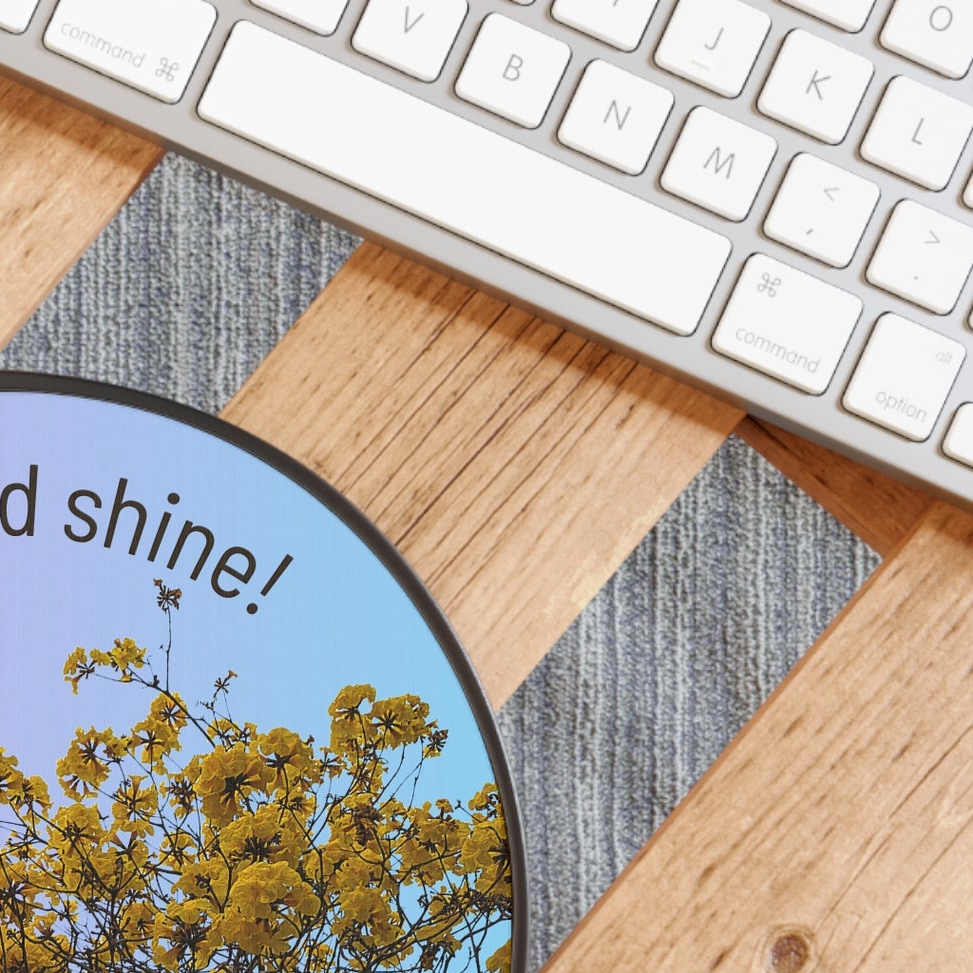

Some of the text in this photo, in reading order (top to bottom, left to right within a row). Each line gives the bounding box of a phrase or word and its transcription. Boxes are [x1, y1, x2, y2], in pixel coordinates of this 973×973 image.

[403, 5, 425, 34] V
[60, 20, 147, 69] command
[703, 26, 725, 51] J
[501, 53, 525, 82] B
[805, 69, 832, 101] K
[602, 99, 632, 131] N
[910, 117, 926, 146] L
[702, 146, 736, 180] M
[734, 326, 821, 374] command
[935, 350, 953, 365] alt
[875, 389, 928, 422] option
[64, 477, 294, 615] shine!
